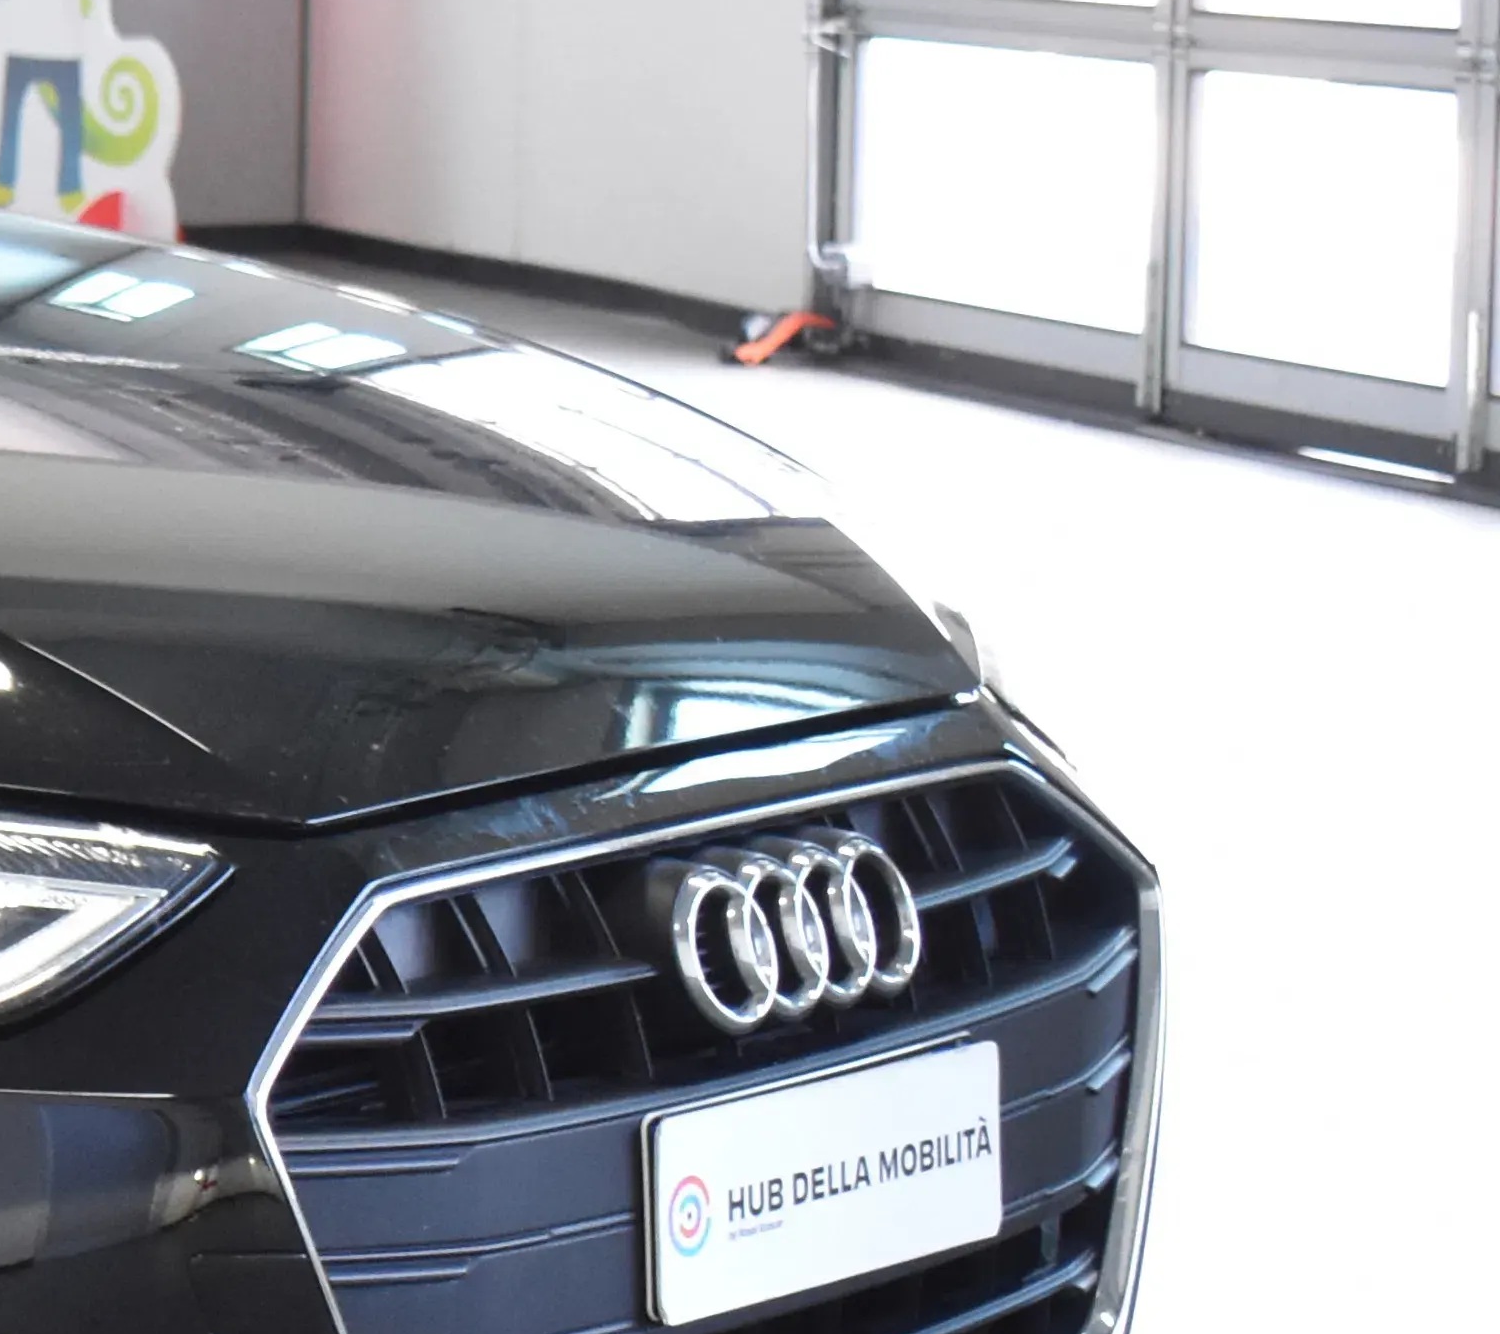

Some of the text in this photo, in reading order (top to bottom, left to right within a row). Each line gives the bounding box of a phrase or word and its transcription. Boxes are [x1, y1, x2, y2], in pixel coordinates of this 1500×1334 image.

[729, 1116, 992, 1221] HUB DELLA MOBILITÀ
